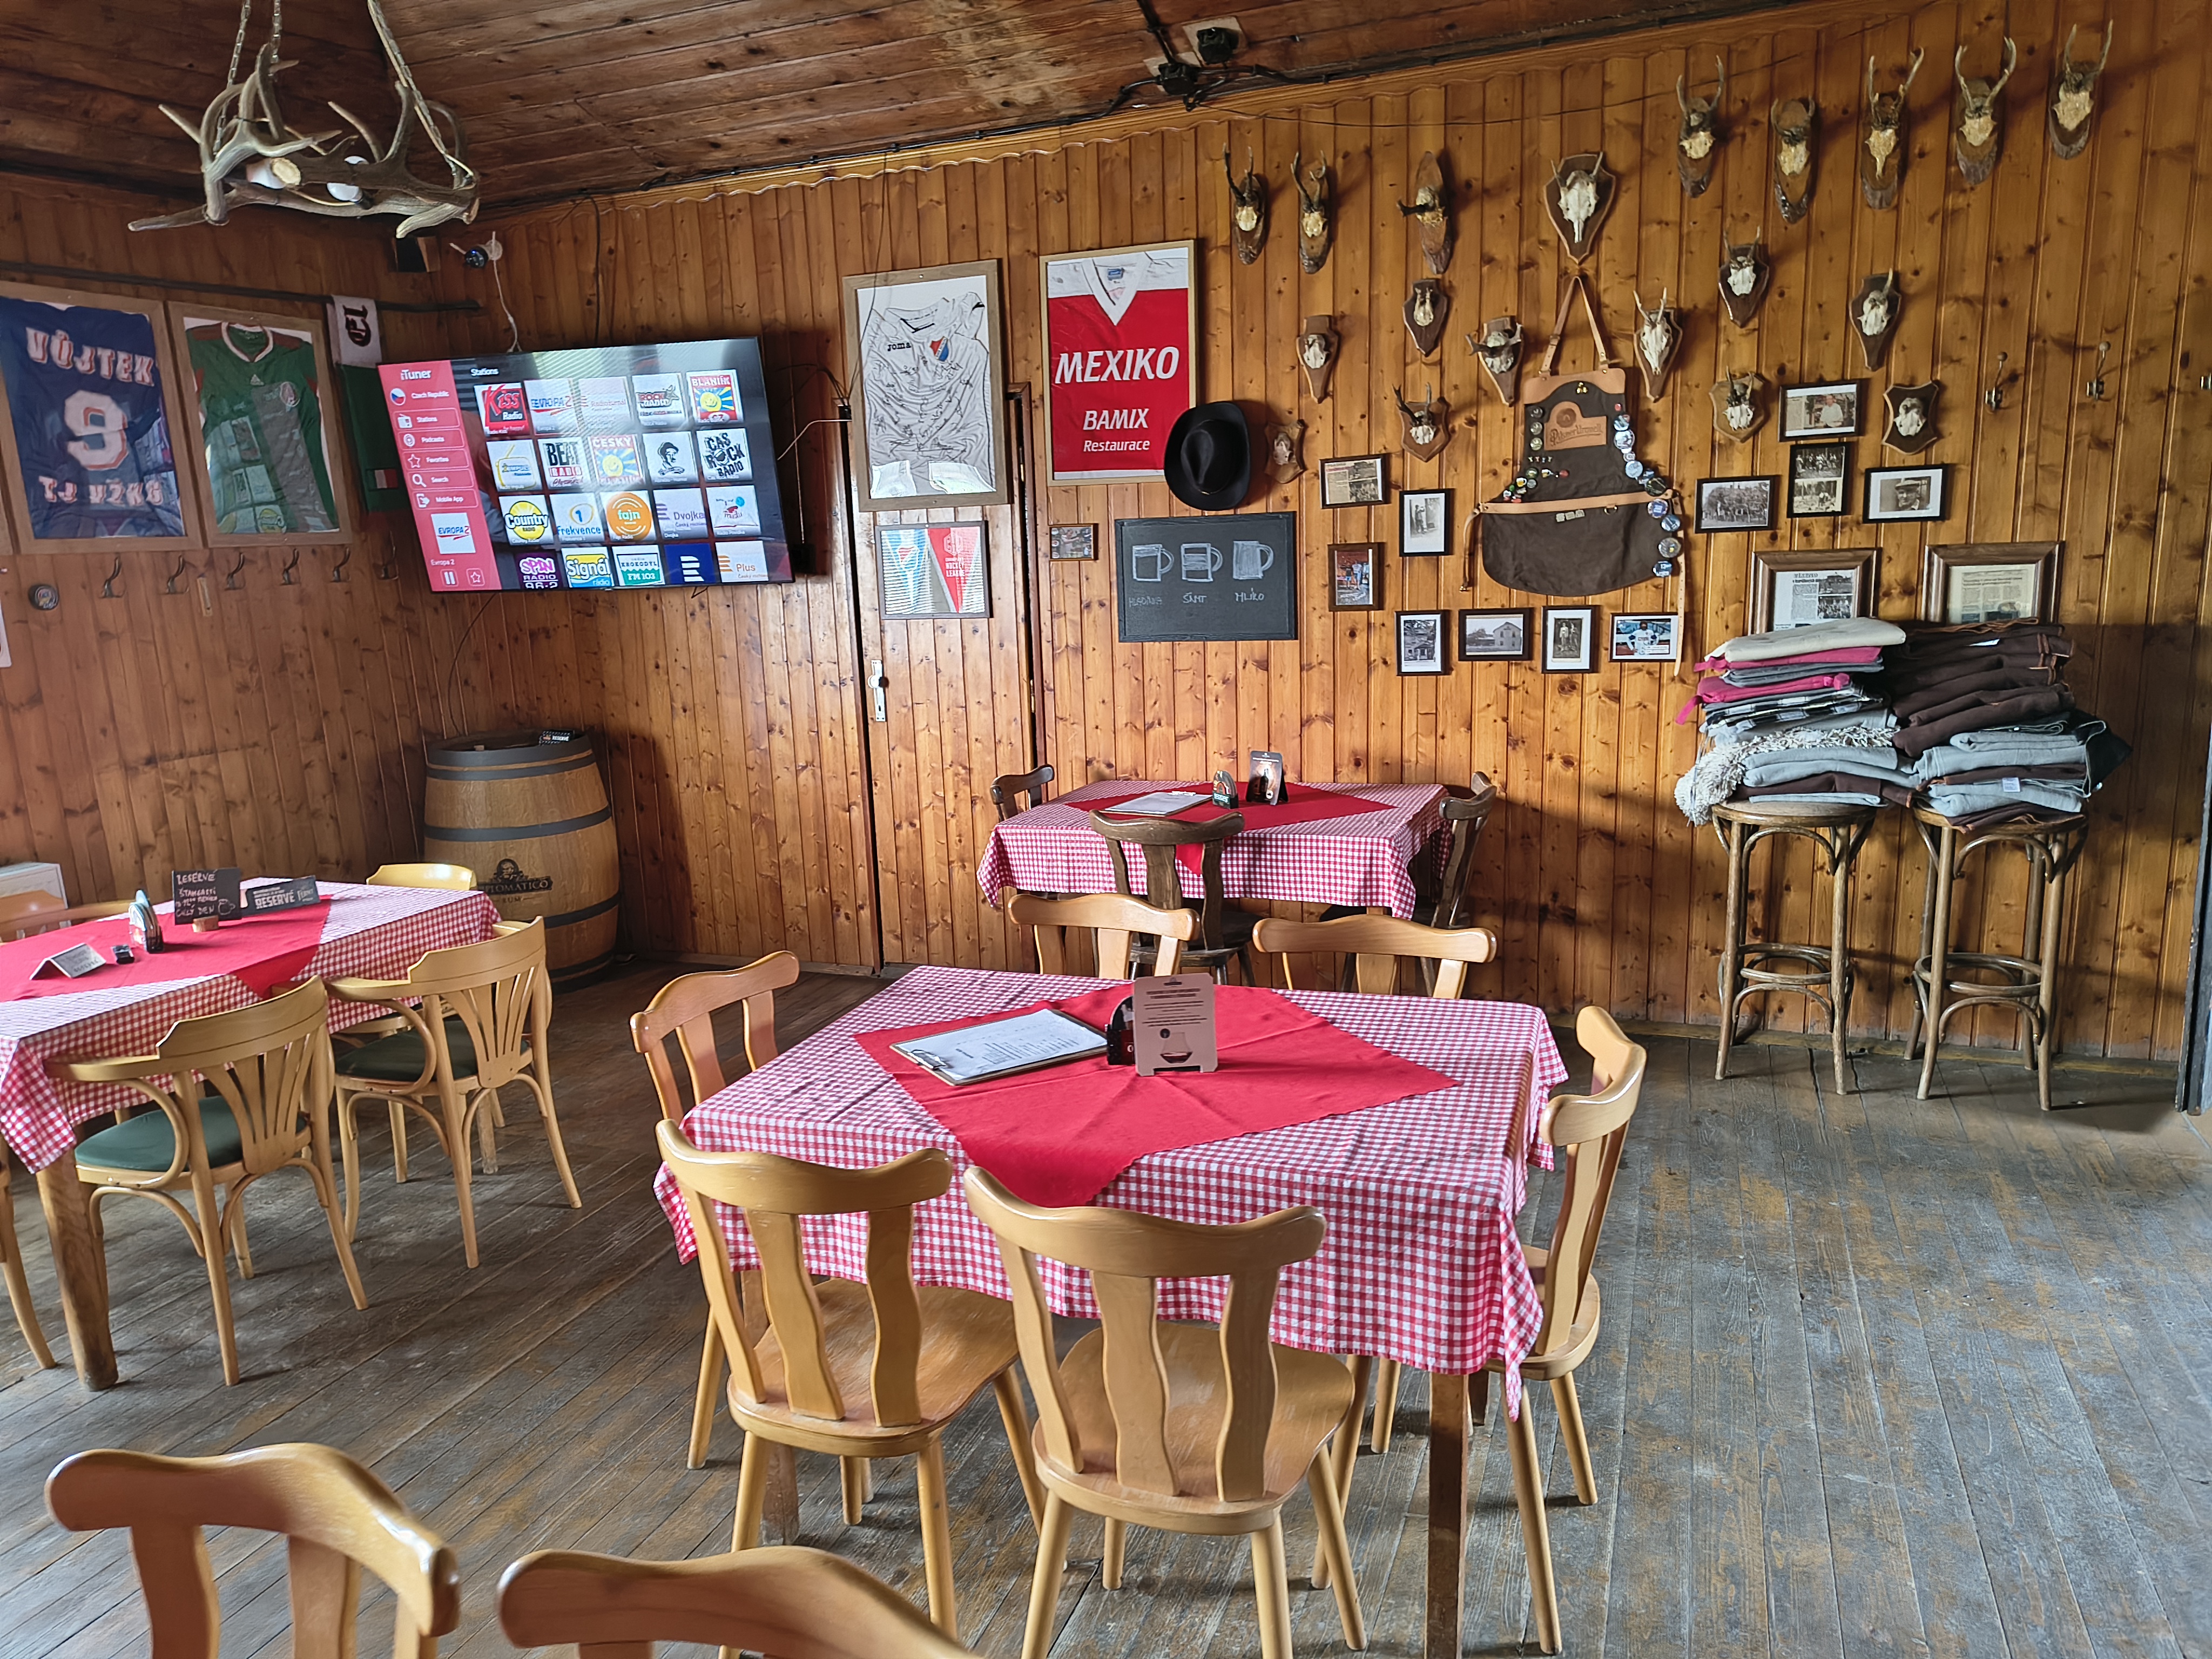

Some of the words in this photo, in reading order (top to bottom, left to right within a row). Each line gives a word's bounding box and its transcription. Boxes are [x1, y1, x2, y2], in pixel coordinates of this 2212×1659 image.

[470, 367, 499, 376] Stations
[1055, 346, 1180, 385] MEXIKO
[400, 369, 431, 380] iTuner
[1083, 408, 1150, 431] BAMIX
[64, 389, 127, 470] 9
[1083, 440, 1150, 453] Restaurace
[504, 513, 549, 529] Country
[575, 510, 583, 522] 1
[617, 509, 641, 521] fajn
[438, 526, 464, 535] EVROPA
[464, 525, 470, 534] 2
[556, 525, 601, 536] Frekvence
[566, 558, 611, 580] Signál
[736, 563, 756, 572] Plus
[627, 572, 642, 581] FM
[254, 890, 296, 909] RESERVÉ
